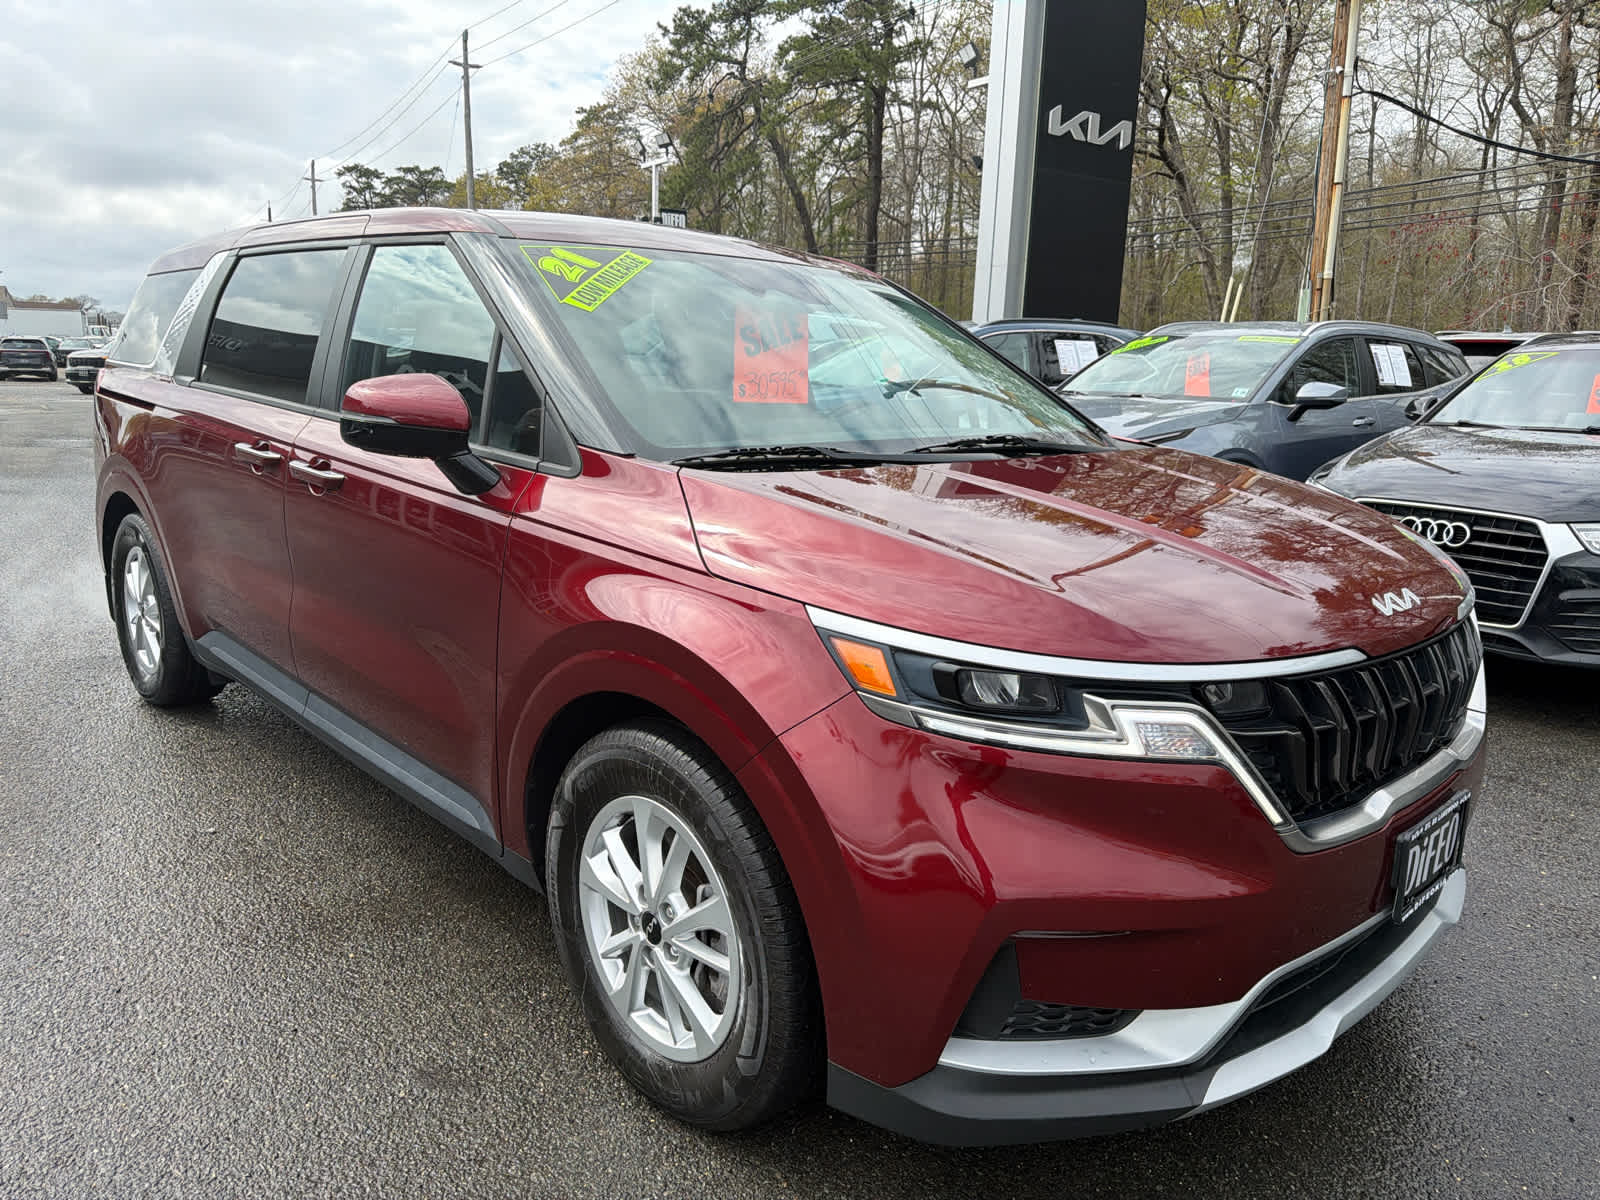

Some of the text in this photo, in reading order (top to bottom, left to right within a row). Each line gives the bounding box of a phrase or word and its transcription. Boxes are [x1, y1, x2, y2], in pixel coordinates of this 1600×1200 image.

[538, 247, 602, 283] 21
[571, 254, 646, 307] LOW MILEAGE
[739, 313, 805, 357] SALE
